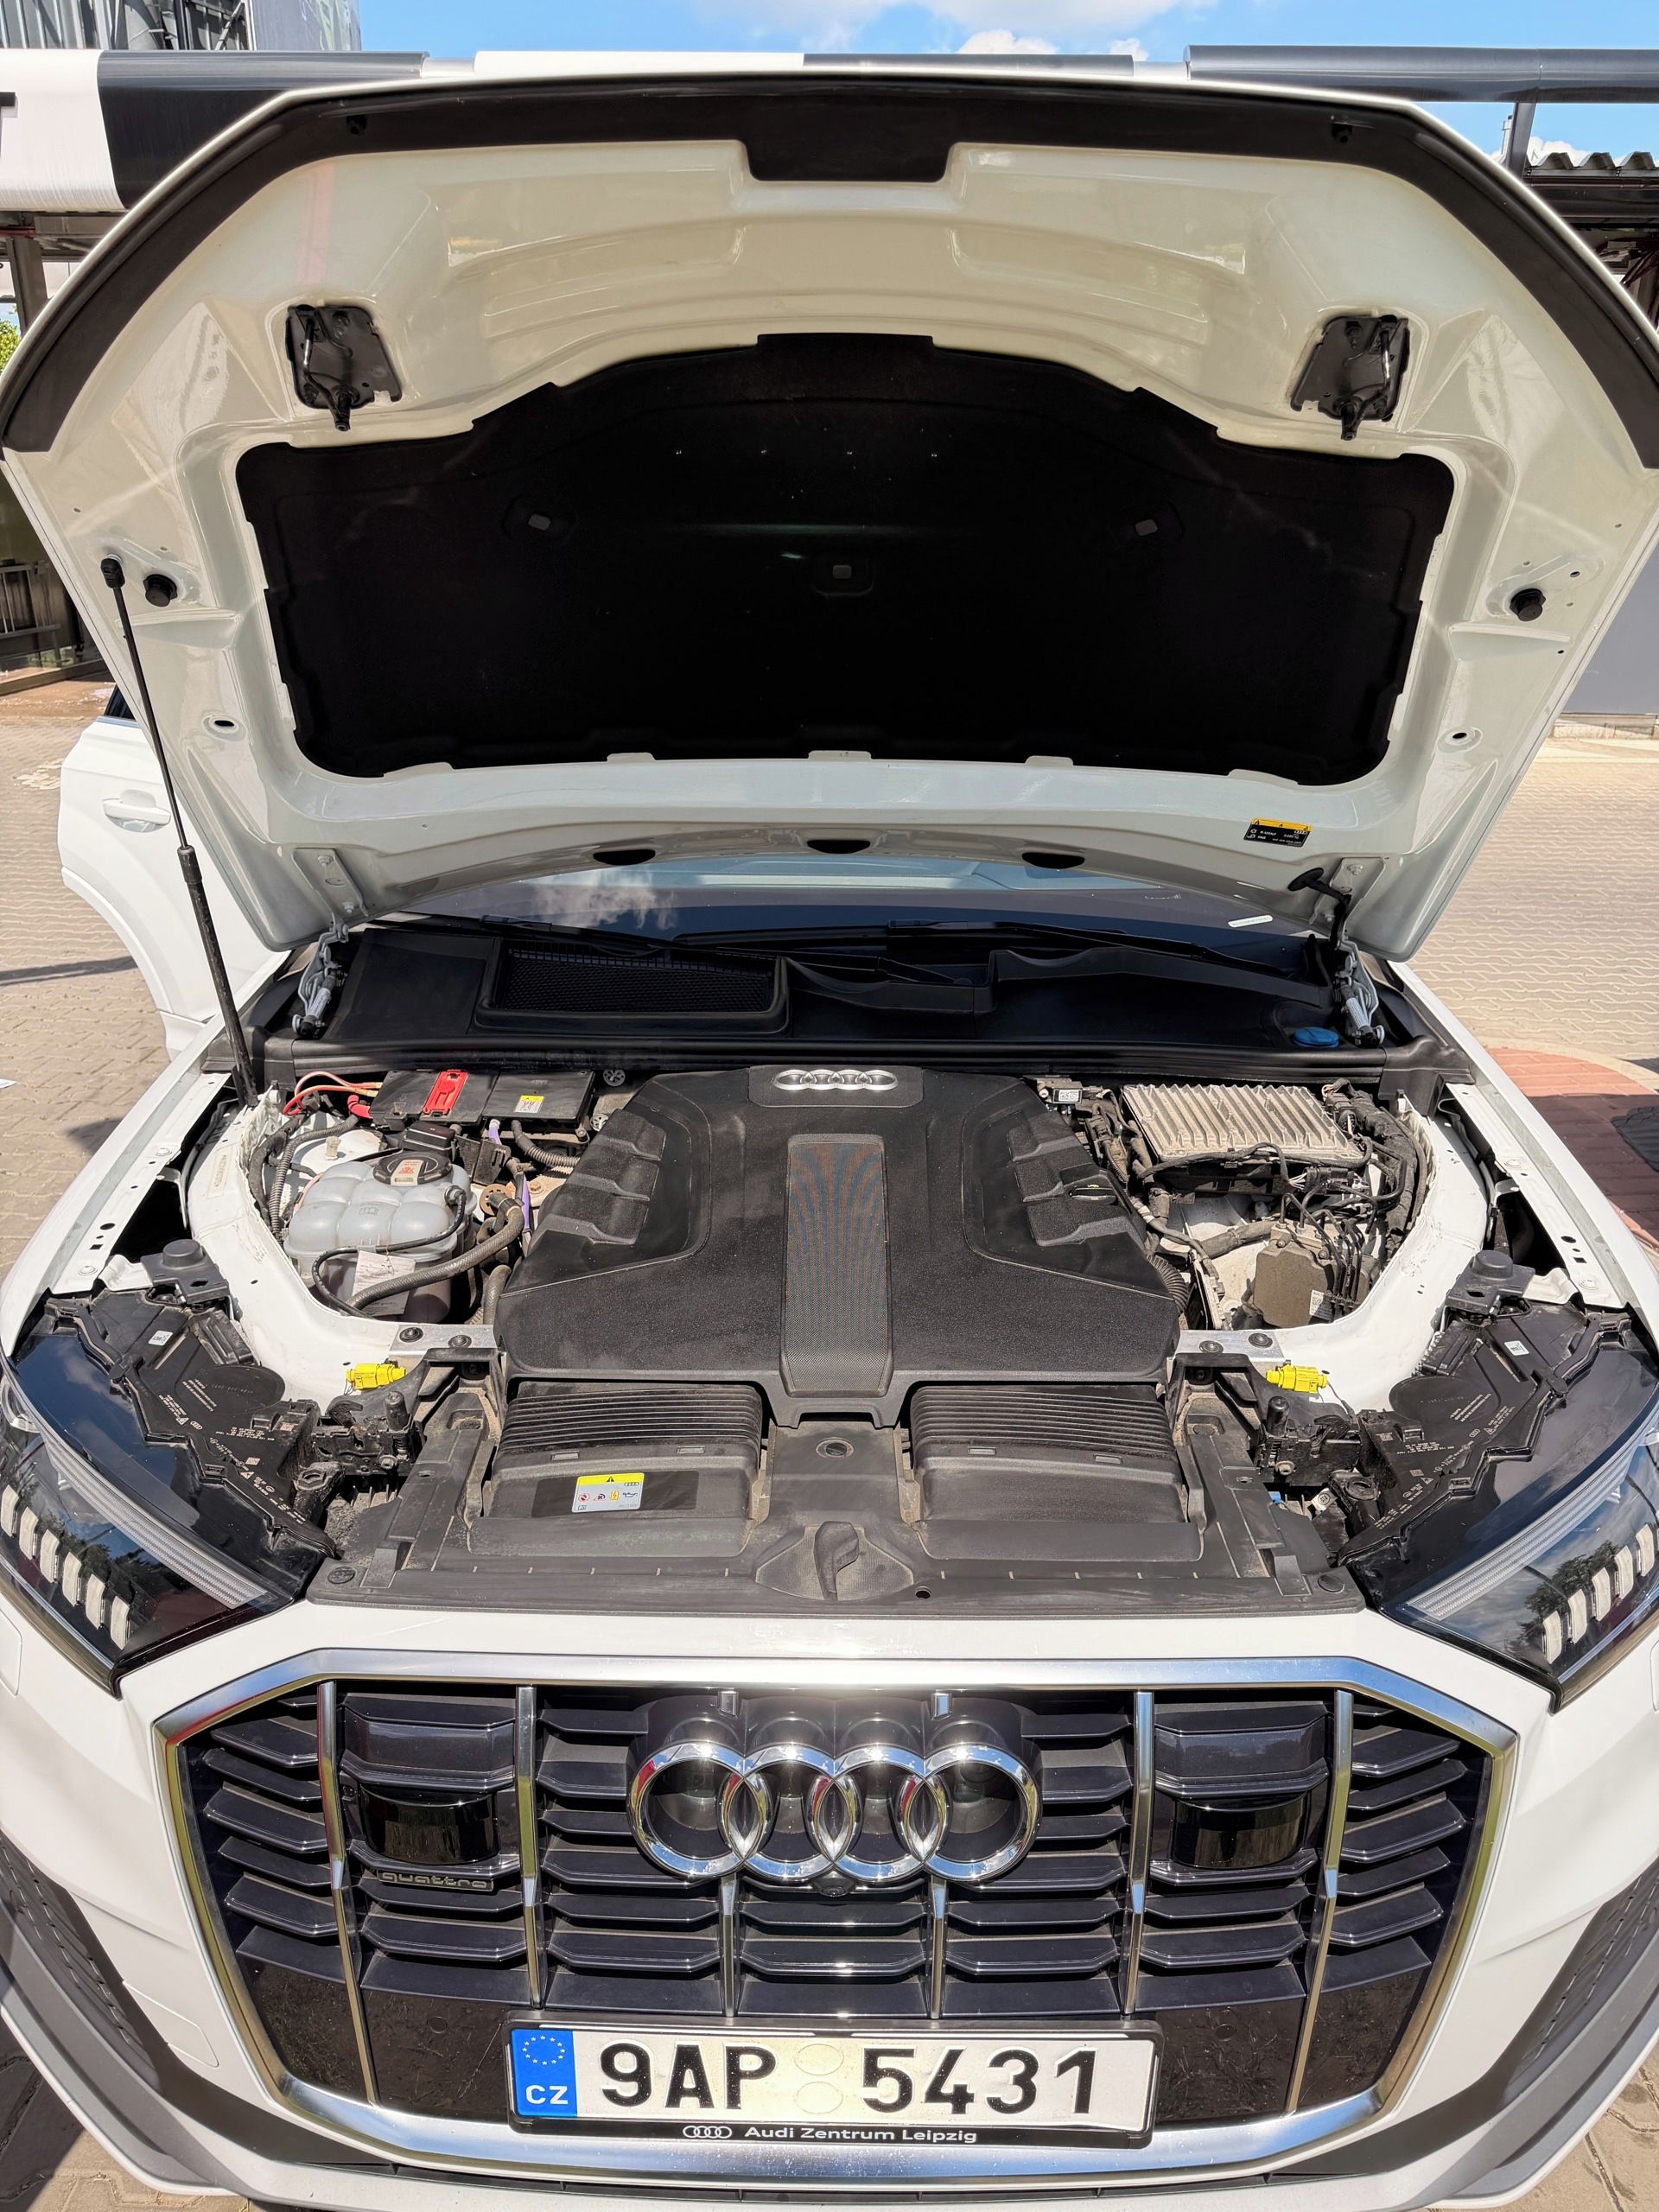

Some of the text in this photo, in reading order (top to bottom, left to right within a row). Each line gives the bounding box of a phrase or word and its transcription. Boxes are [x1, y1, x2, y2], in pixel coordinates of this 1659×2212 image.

[382, 1872, 487, 1889] quattro
[601, 2042, 1096, 2114] 9AP 5431
[525, 2084, 569, 2105] CZ
[744, 2126, 977, 2143] Audi Zentrum Leipzig
